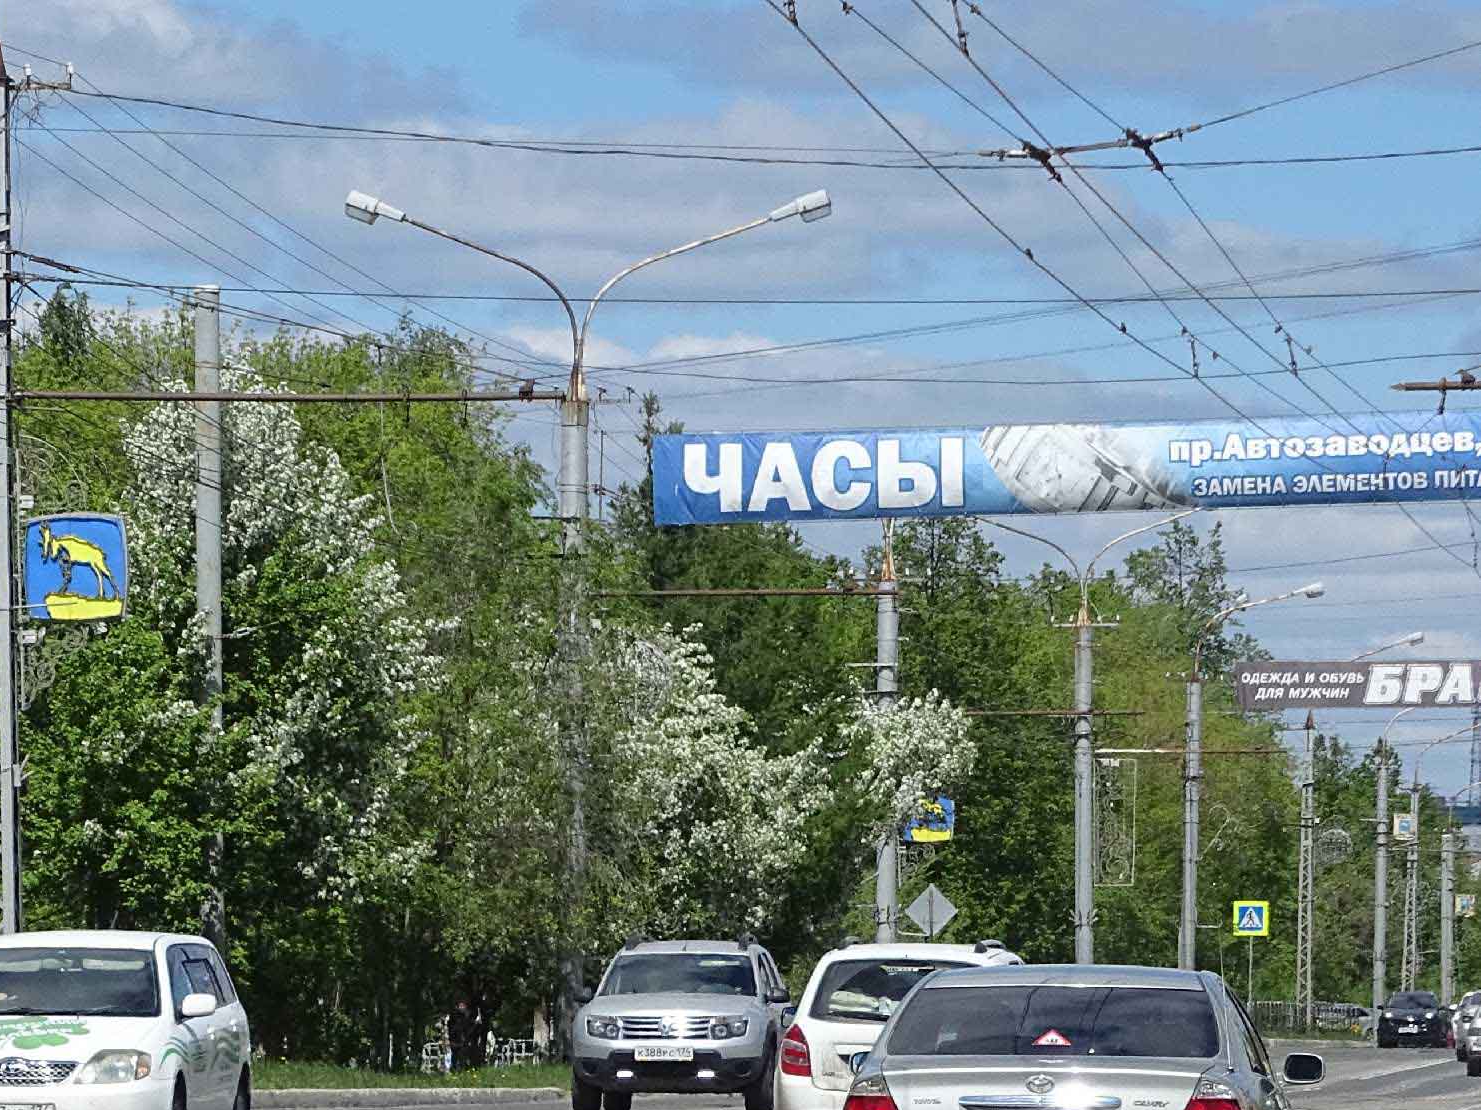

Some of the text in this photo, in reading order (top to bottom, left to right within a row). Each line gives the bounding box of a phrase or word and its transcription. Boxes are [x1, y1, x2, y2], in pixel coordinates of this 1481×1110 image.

[683, 437, 965, 513] ЧАСЫ
[1192, 468, 1481, 497] ЗАМЕНА ЭЛЕМЕНТОВ ПИТ
[1241, 671, 1365, 685] ОДЕЖДА И ОБУВЬ
[1363, 663, 1481, 705] БРА
[1254, 686, 1350, 701] ДЛЯ МУЖЧИН
